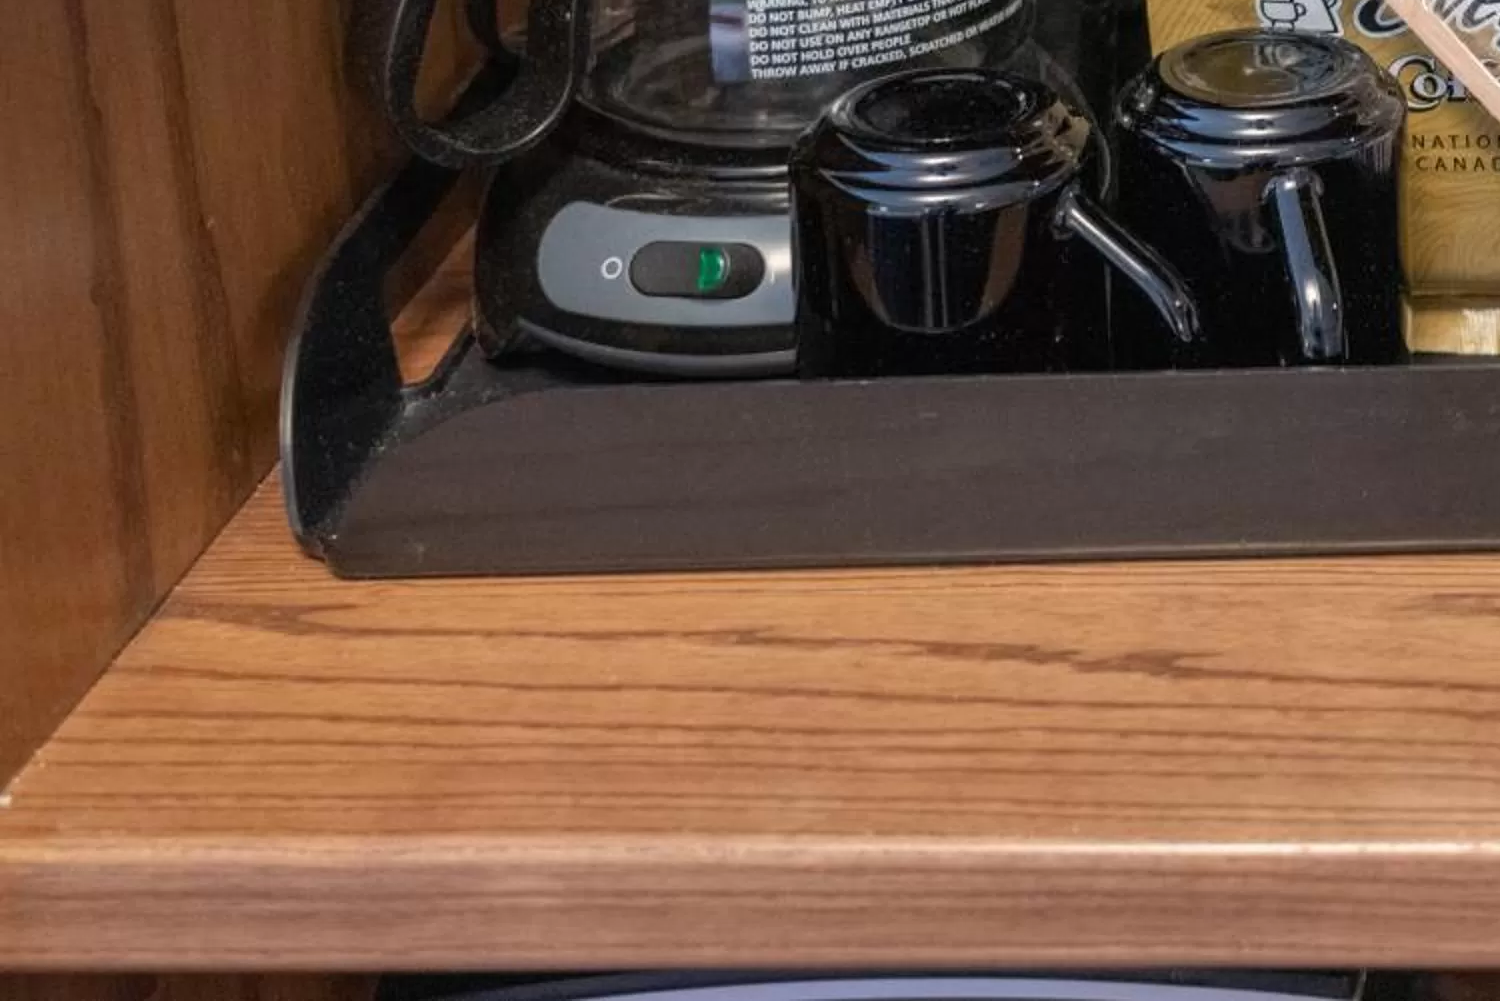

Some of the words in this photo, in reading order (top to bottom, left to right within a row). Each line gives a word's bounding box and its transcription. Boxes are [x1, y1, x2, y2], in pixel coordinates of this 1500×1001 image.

[748, 13, 767, 24] DO
[769, 11, 794, 22] NOT
[836, 2, 865, 15] HEAT
[749, 27, 767, 39] DO
[770, 25, 795, 37] NOT
[798, 20, 837, 34] CLEAN
[839, 15, 870, 29] WITH
[872, 2, 931, 24] MATERIALS
[750, 41, 768, 52] DO
[771, 38, 797, 50] NOT
[799, 35, 824, 48] USE
[825, 33, 844, 45] ON
[847, 28, 872, 41] ANY
[874, 15, 931, 37] RANGETOP
[751, 55, 769, 66] DO
[772, 52, 798, 64] NOT
[801, 49, 834, 62] HOLD
[837, 42, 869, 57] OVER
[870, 33, 912, 53] PEOPLE
[751, 66, 797, 80] THROW
[799, 62, 836, 76] AWAY
[838, 59, 849, 71] IF
[908, 31, 965, 57] SCRATCHED
